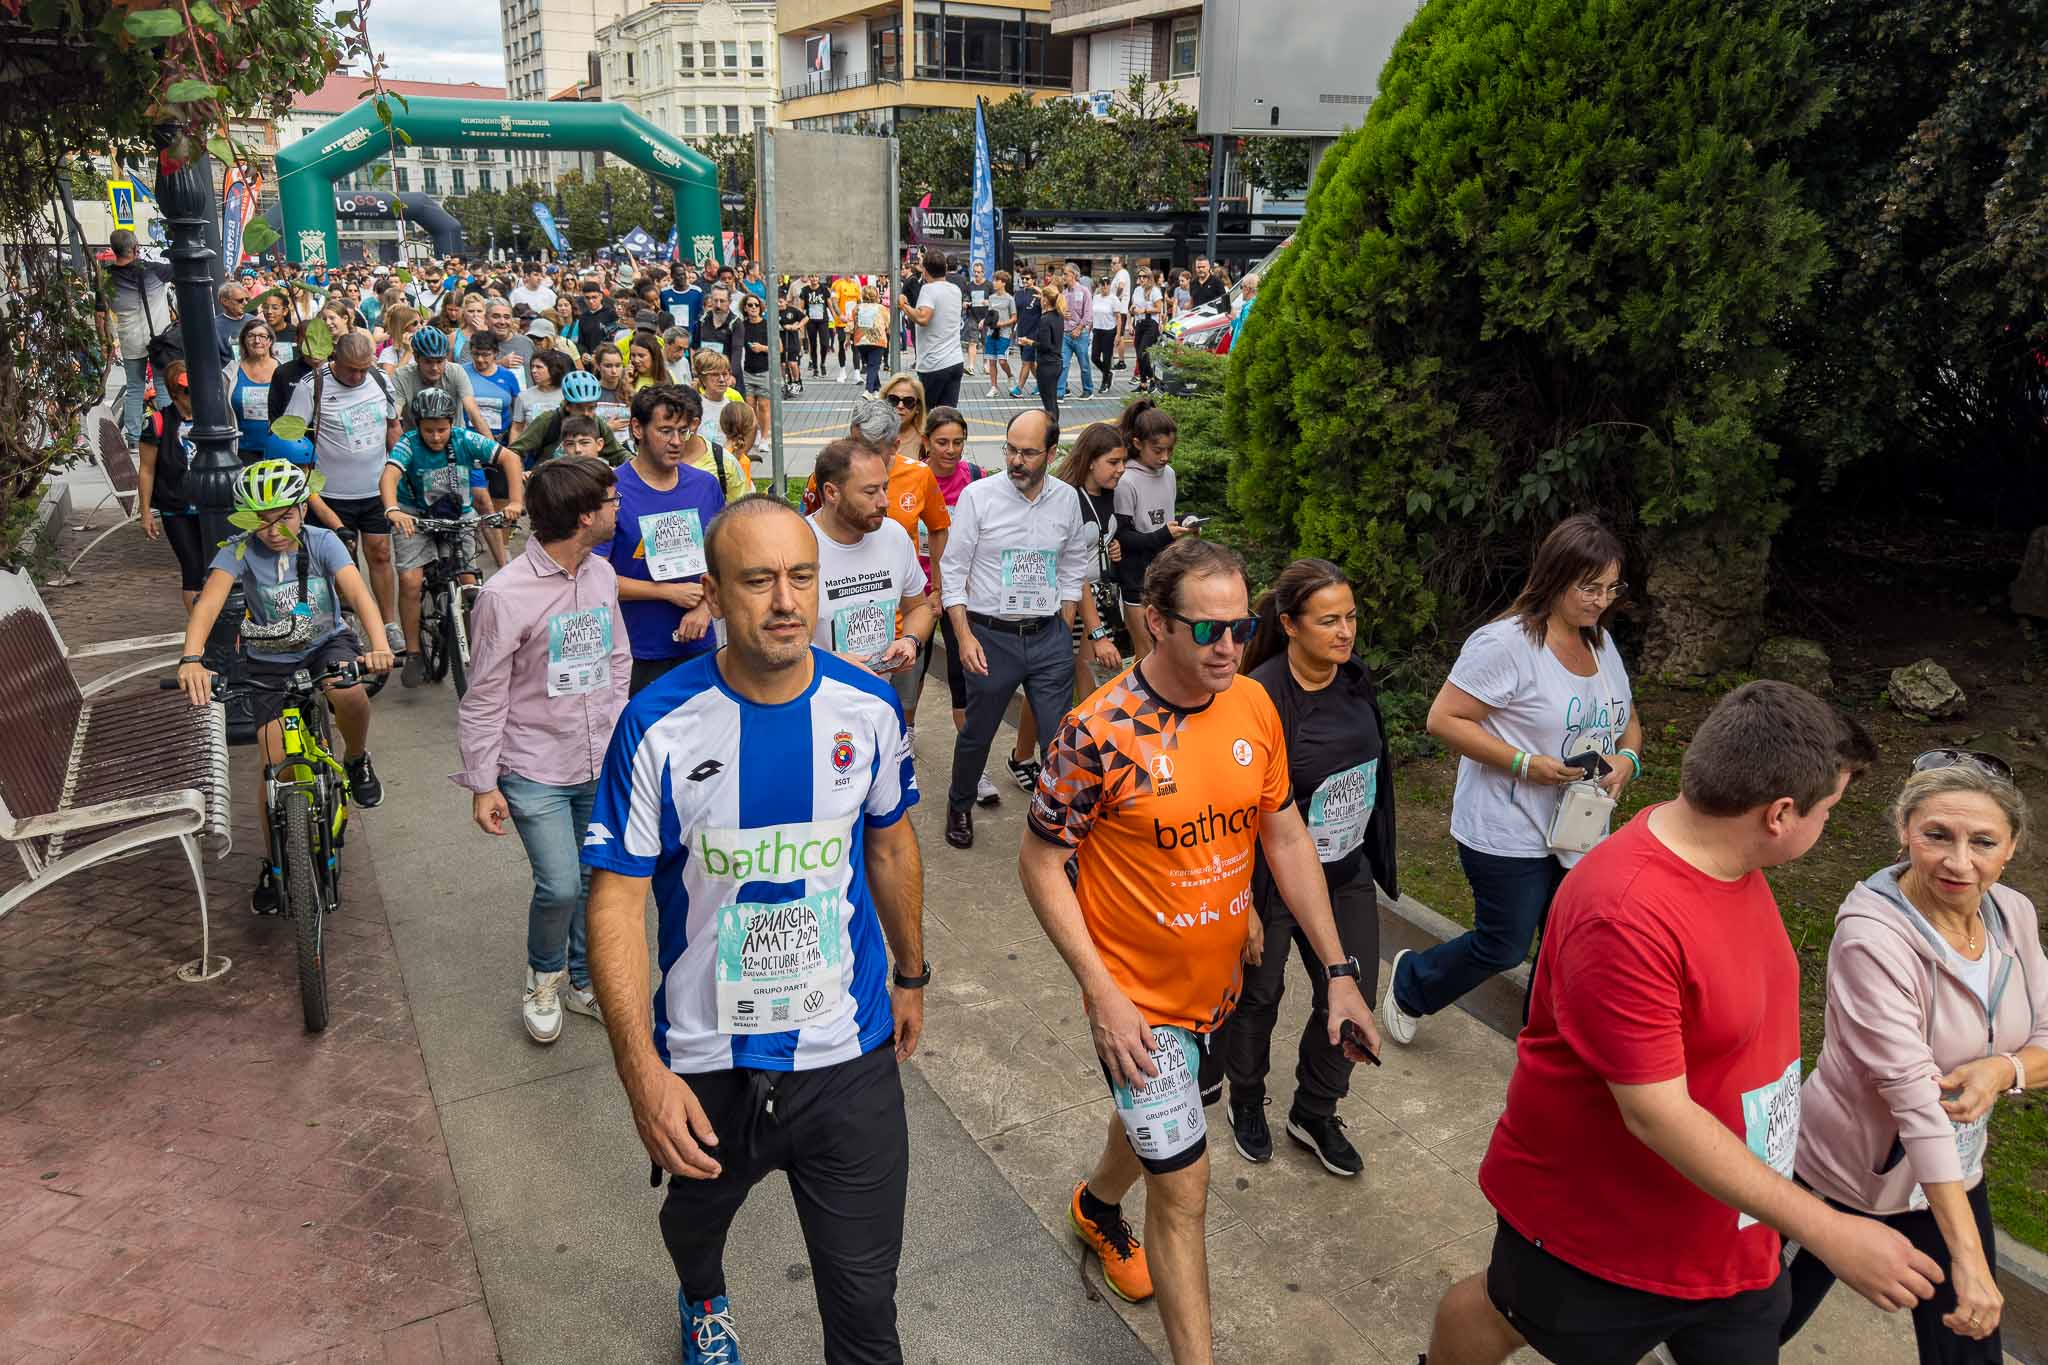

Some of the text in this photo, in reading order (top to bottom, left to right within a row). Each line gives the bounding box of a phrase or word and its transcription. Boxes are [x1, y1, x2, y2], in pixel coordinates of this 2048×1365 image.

[922, 212, 969, 228] MURANO
[825, 569, 890, 588] Marcha Popular
[838, 581, 885, 597] BRIDGESTONE
[1153, 804, 1258, 850] bathco
[701, 831, 842, 879] bathco
[756, 906, 817, 932] MARCHA
[742, 926, 818, 955] AMAT 2024
[761, 952, 800, 970] OCTUBRE
[753, 983, 808, 995] GRUPO PARTE
[1145, 1075, 1176, 1096] OCTUBRE
[1145, 1109, 1170, 1121] GRUPO
